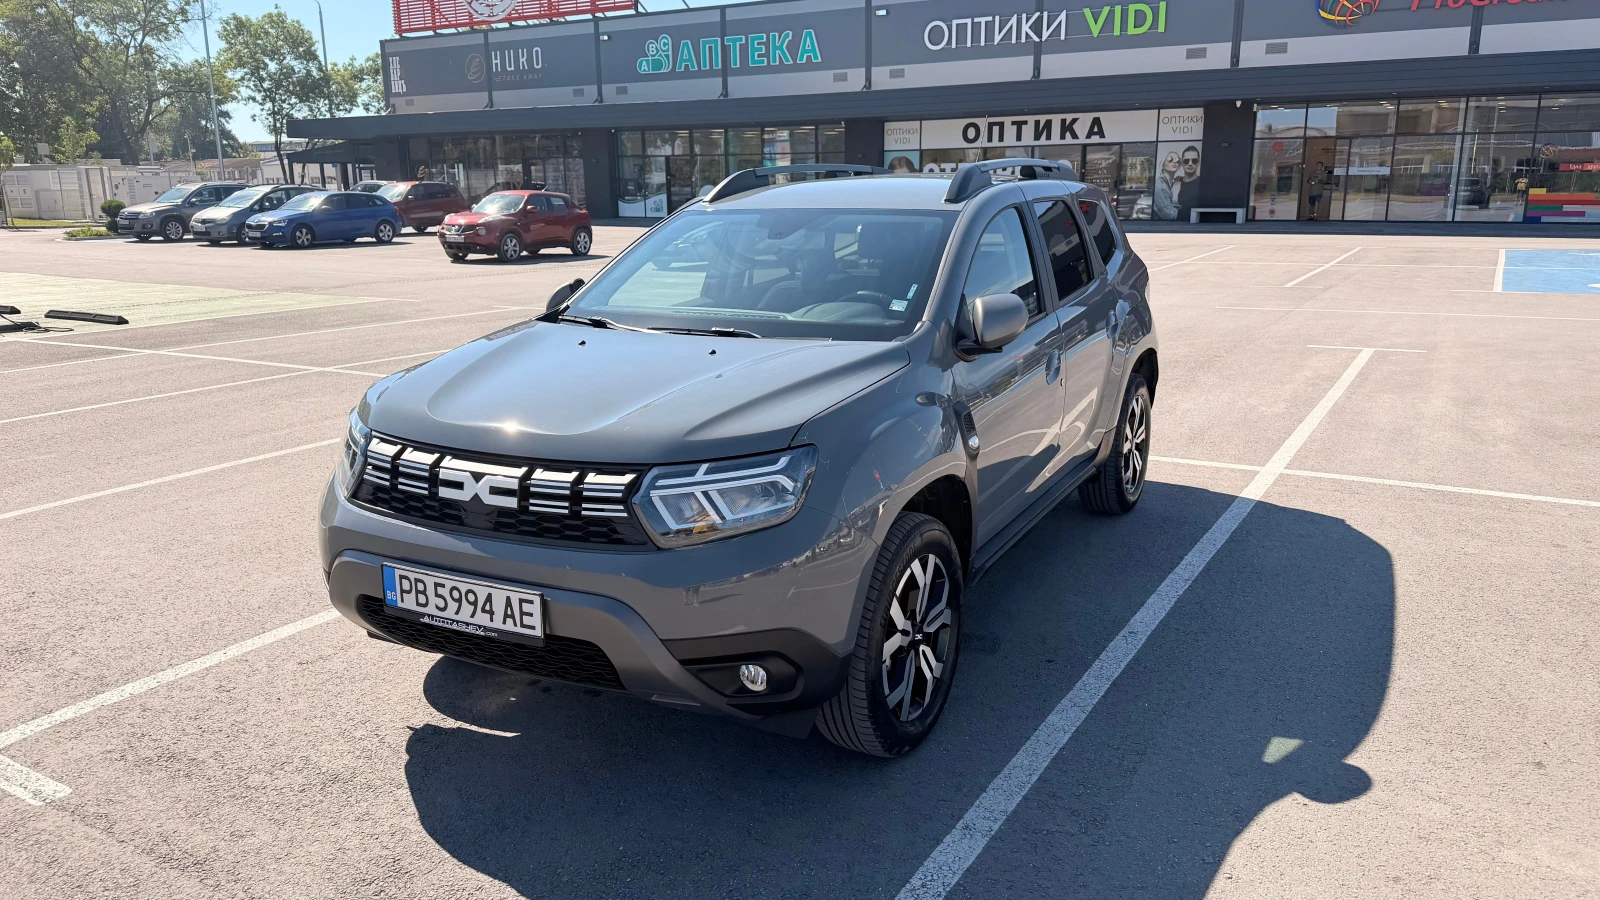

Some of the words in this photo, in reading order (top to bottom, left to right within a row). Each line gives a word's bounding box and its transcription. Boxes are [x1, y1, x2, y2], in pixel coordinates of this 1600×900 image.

[923, 9, 1066, 51] ОПТИКИ
[1082, 0, 1167, 38] VIDI
[675, 29, 822, 72] АПТЕКА
[502, 74, 520, 82] TAKE
[523, 73, 543, 81] AWAY
[1161, 115, 1204, 125] ОПТИКИ
[886, 127, 919, 137] ОПТИКИ
[961, 116, 1106, 144] ОПТИКА
[1171, 125, 1194, 134] VIDI
[893, 136, 912, 145] VIDI
[386, 590, 397, 601] BG
[398, 574, 430, 609] PB
[433, 581, 496, 623] 5994
[502, 595, 537, 631] AE
